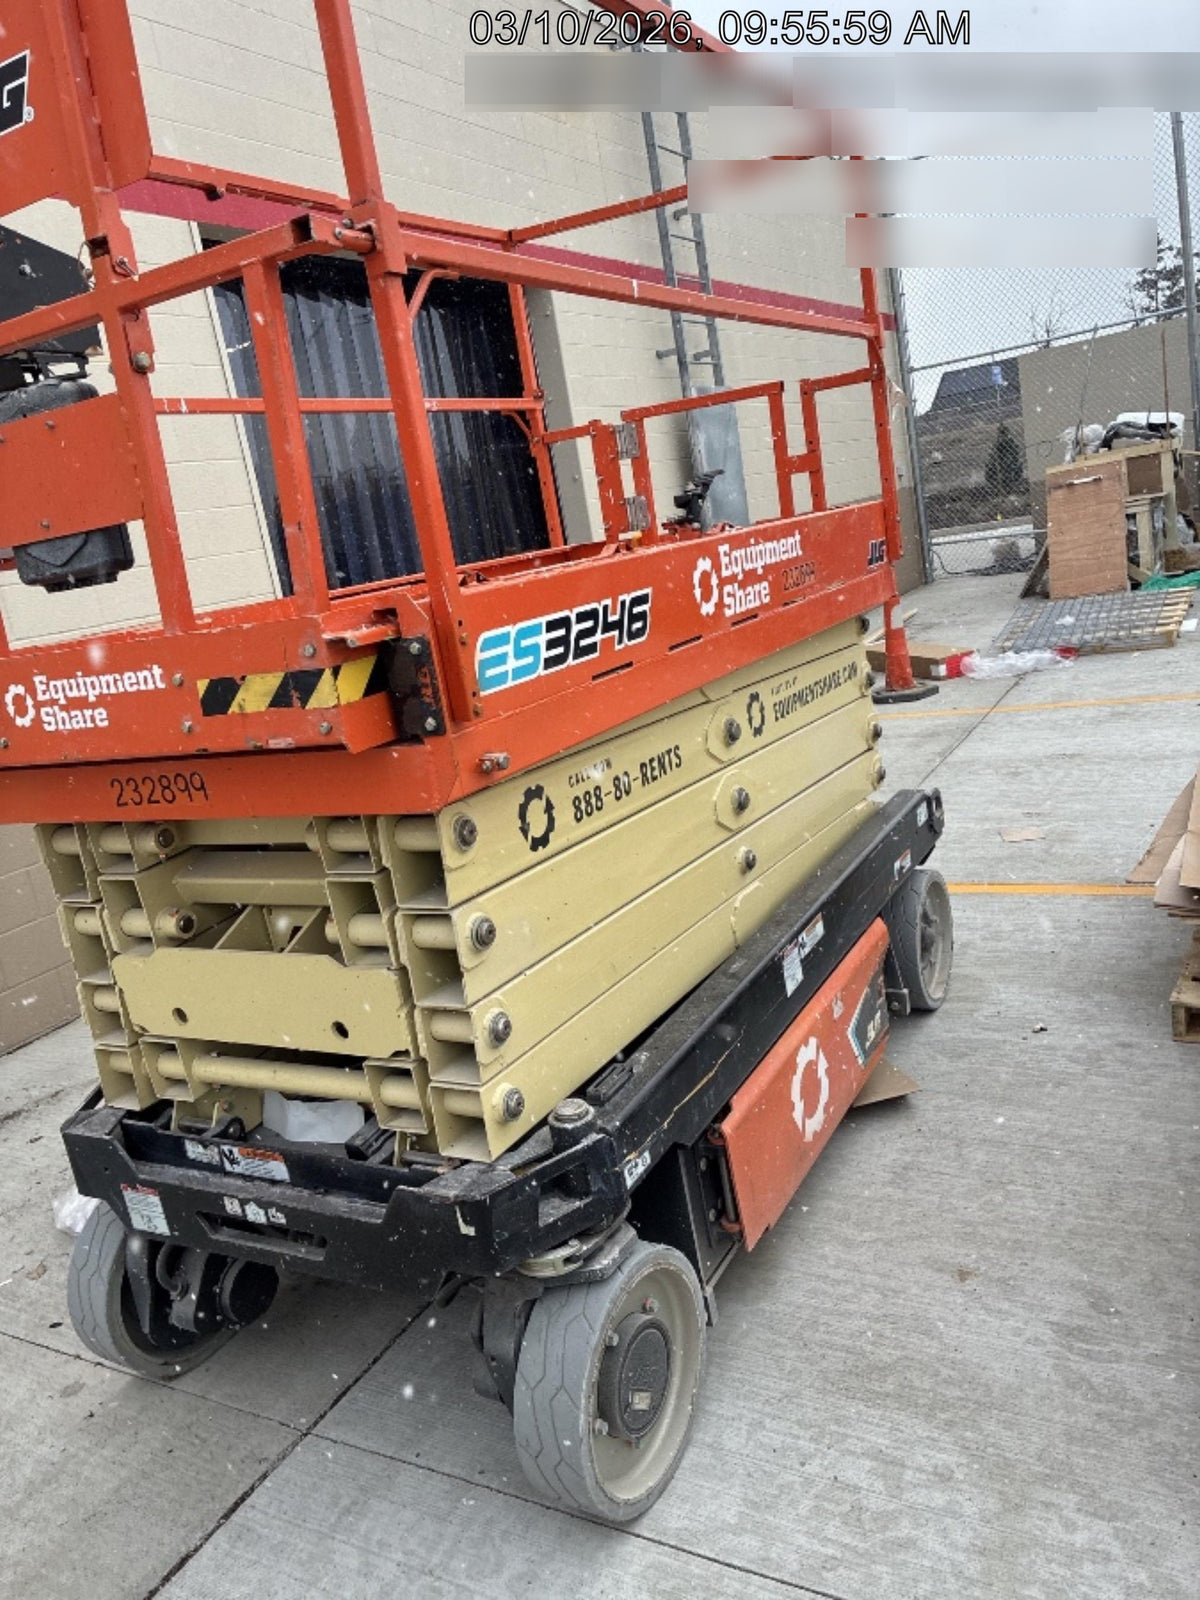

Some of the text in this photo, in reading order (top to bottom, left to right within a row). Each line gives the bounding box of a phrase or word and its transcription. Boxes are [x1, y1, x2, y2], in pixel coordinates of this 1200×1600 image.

[718, 530, 803, 580] Equipment
[722, 580, 771, 617] Share
[474, 587, 653, 697] ES3246
[33, 665, 166, 704] Equipment
[40, 707, 109, 732] Share
[110, 771, 209, 808] 232899
[572, 744, 683, 823] 888-80-RENTS
